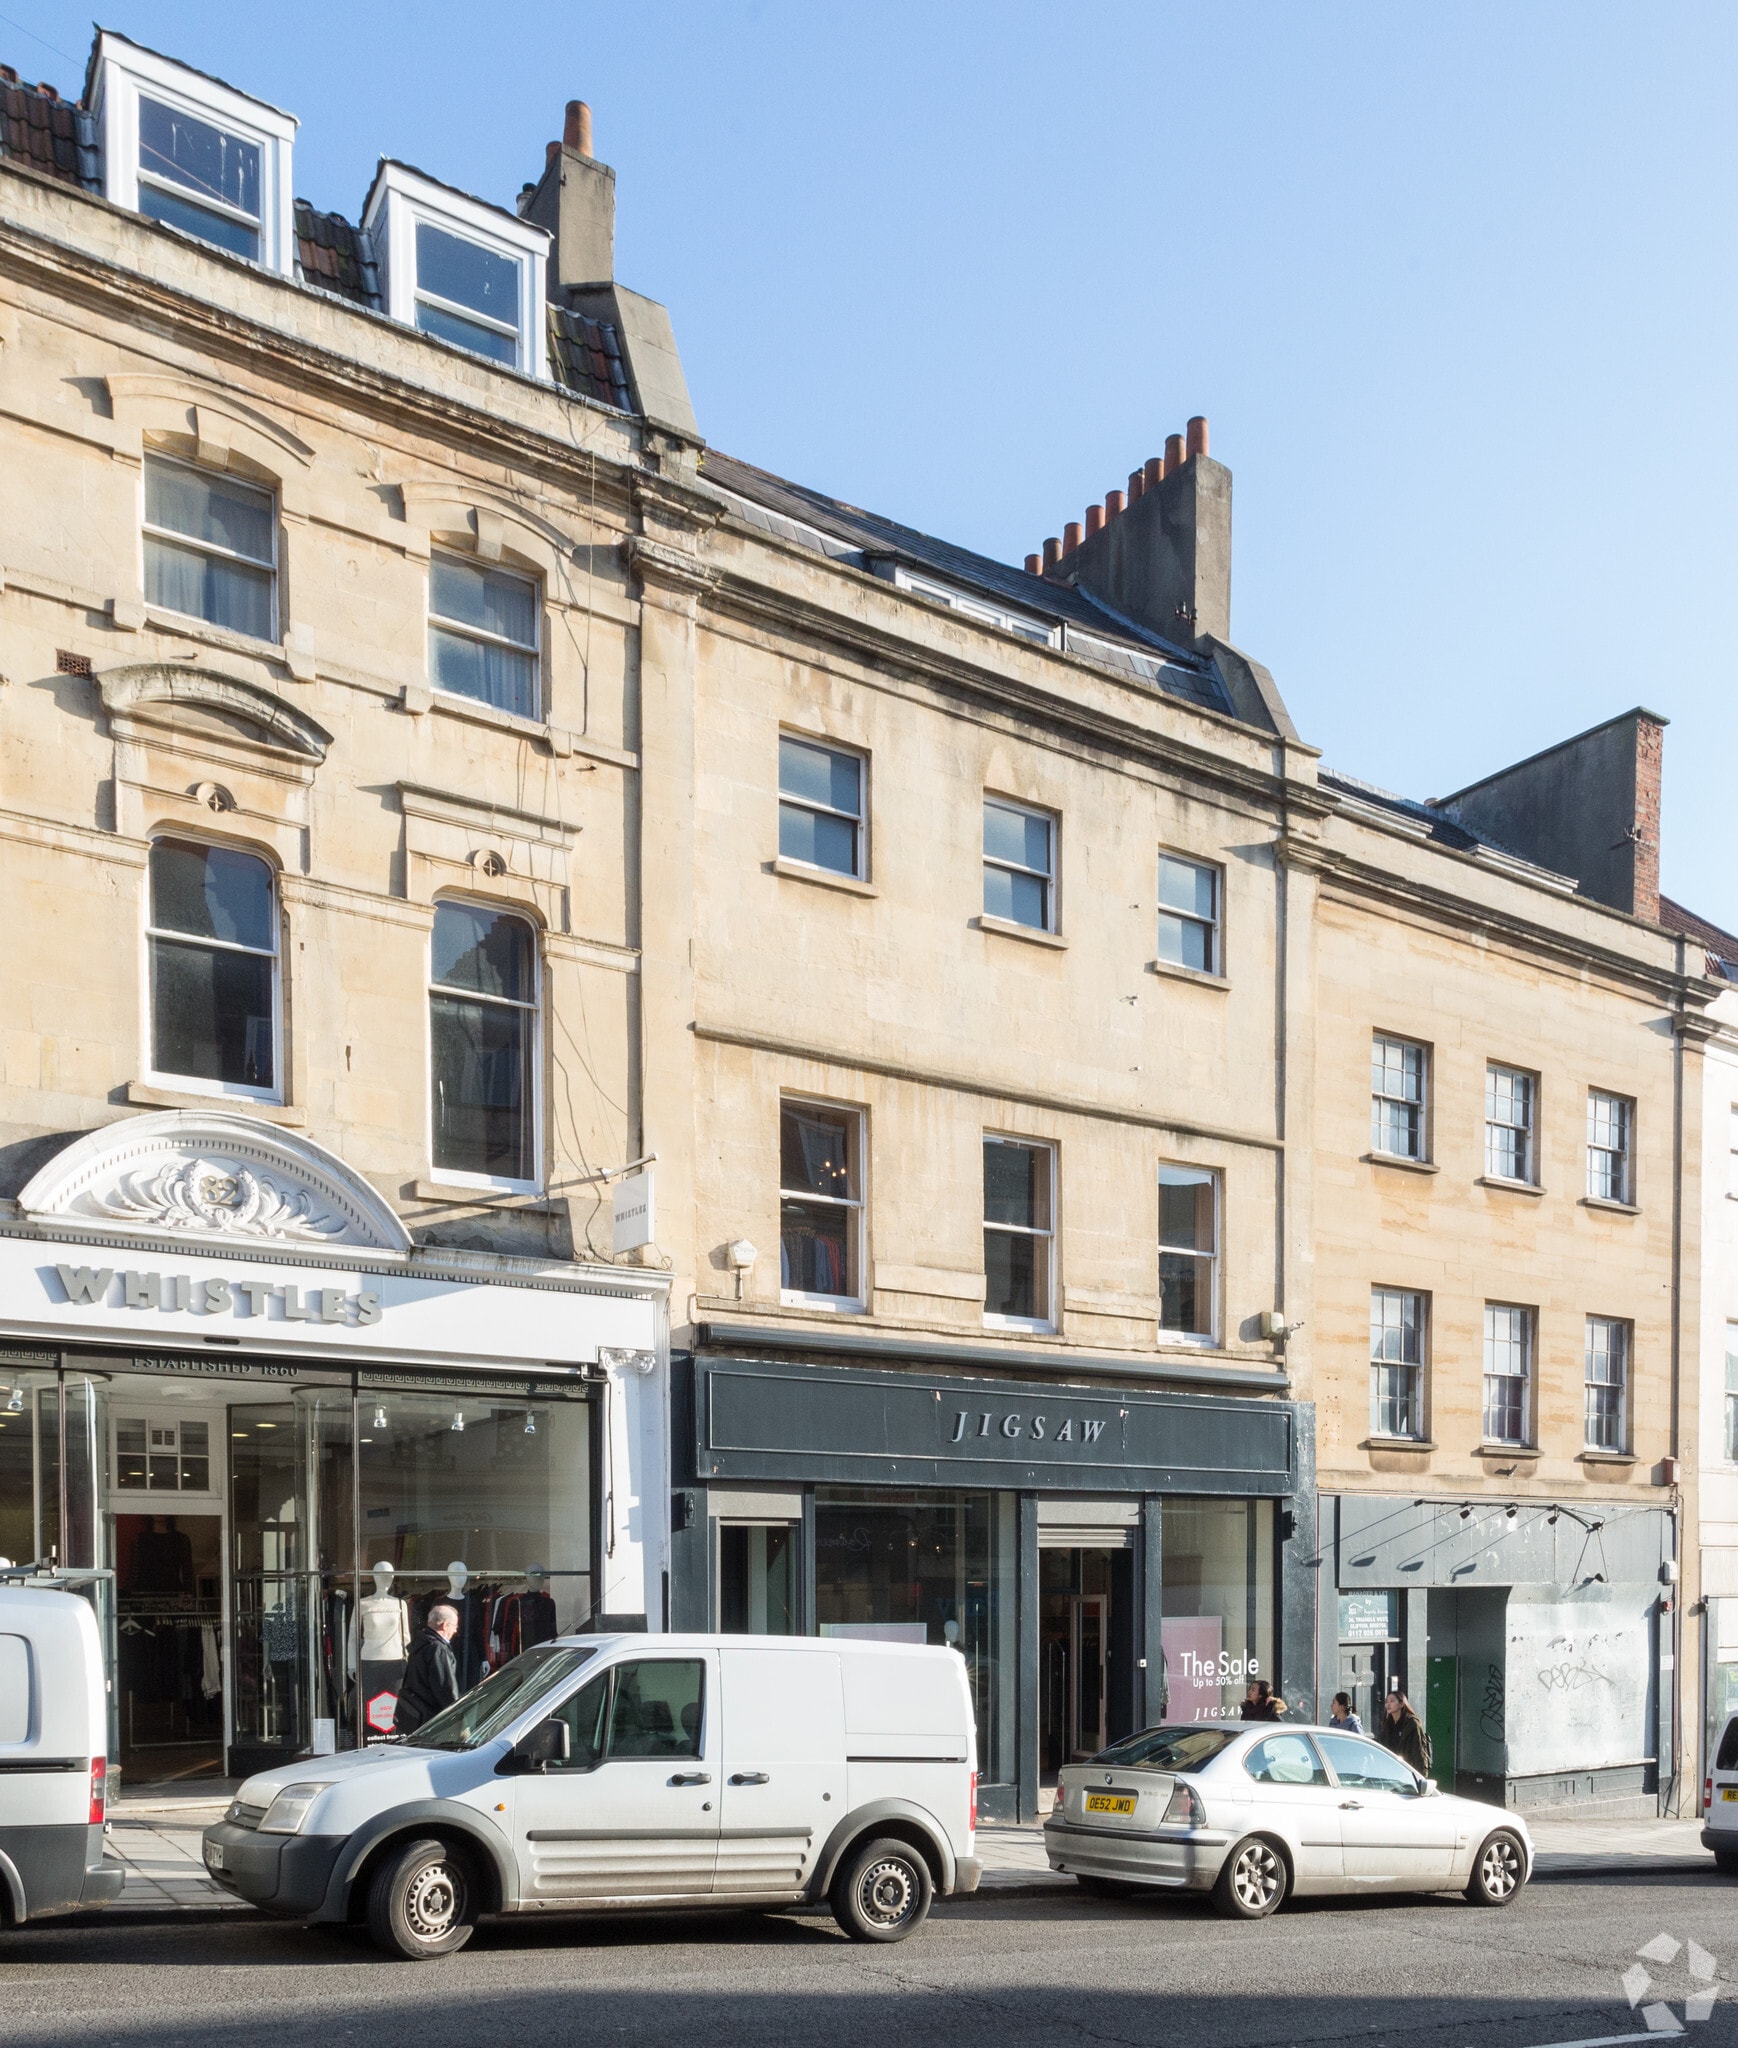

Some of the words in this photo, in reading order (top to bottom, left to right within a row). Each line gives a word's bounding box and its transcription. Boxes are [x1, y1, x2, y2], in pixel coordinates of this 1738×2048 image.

[199, 1175, 238, 1205] 82
[615, 1203, 647, 1224] WHISTLES
[55, 1263, 383, 1326] WHISTLES
[132, 1357, 252, 1375] ESTABLISHED
[262, 1364, 299, 1377] 1860
[949, 1411, 1107, 1443] JIGSAW
[1180, 1650, 1215, 1677] The
[1217, 1648, 1259, 1676] Sale
[1193, 1678, 1204, 1690] Up
[1206, 1678, 1213, 1687] to
[1215, 1676, 1232, 1686] 50%
[1234, 1674, 1245, 1685] off
[1089, 1797, 1109, 1810] OE52
[1112, 1799, 1130, 1812] JWD
[1728, 1790, 1738, 1800] RE
